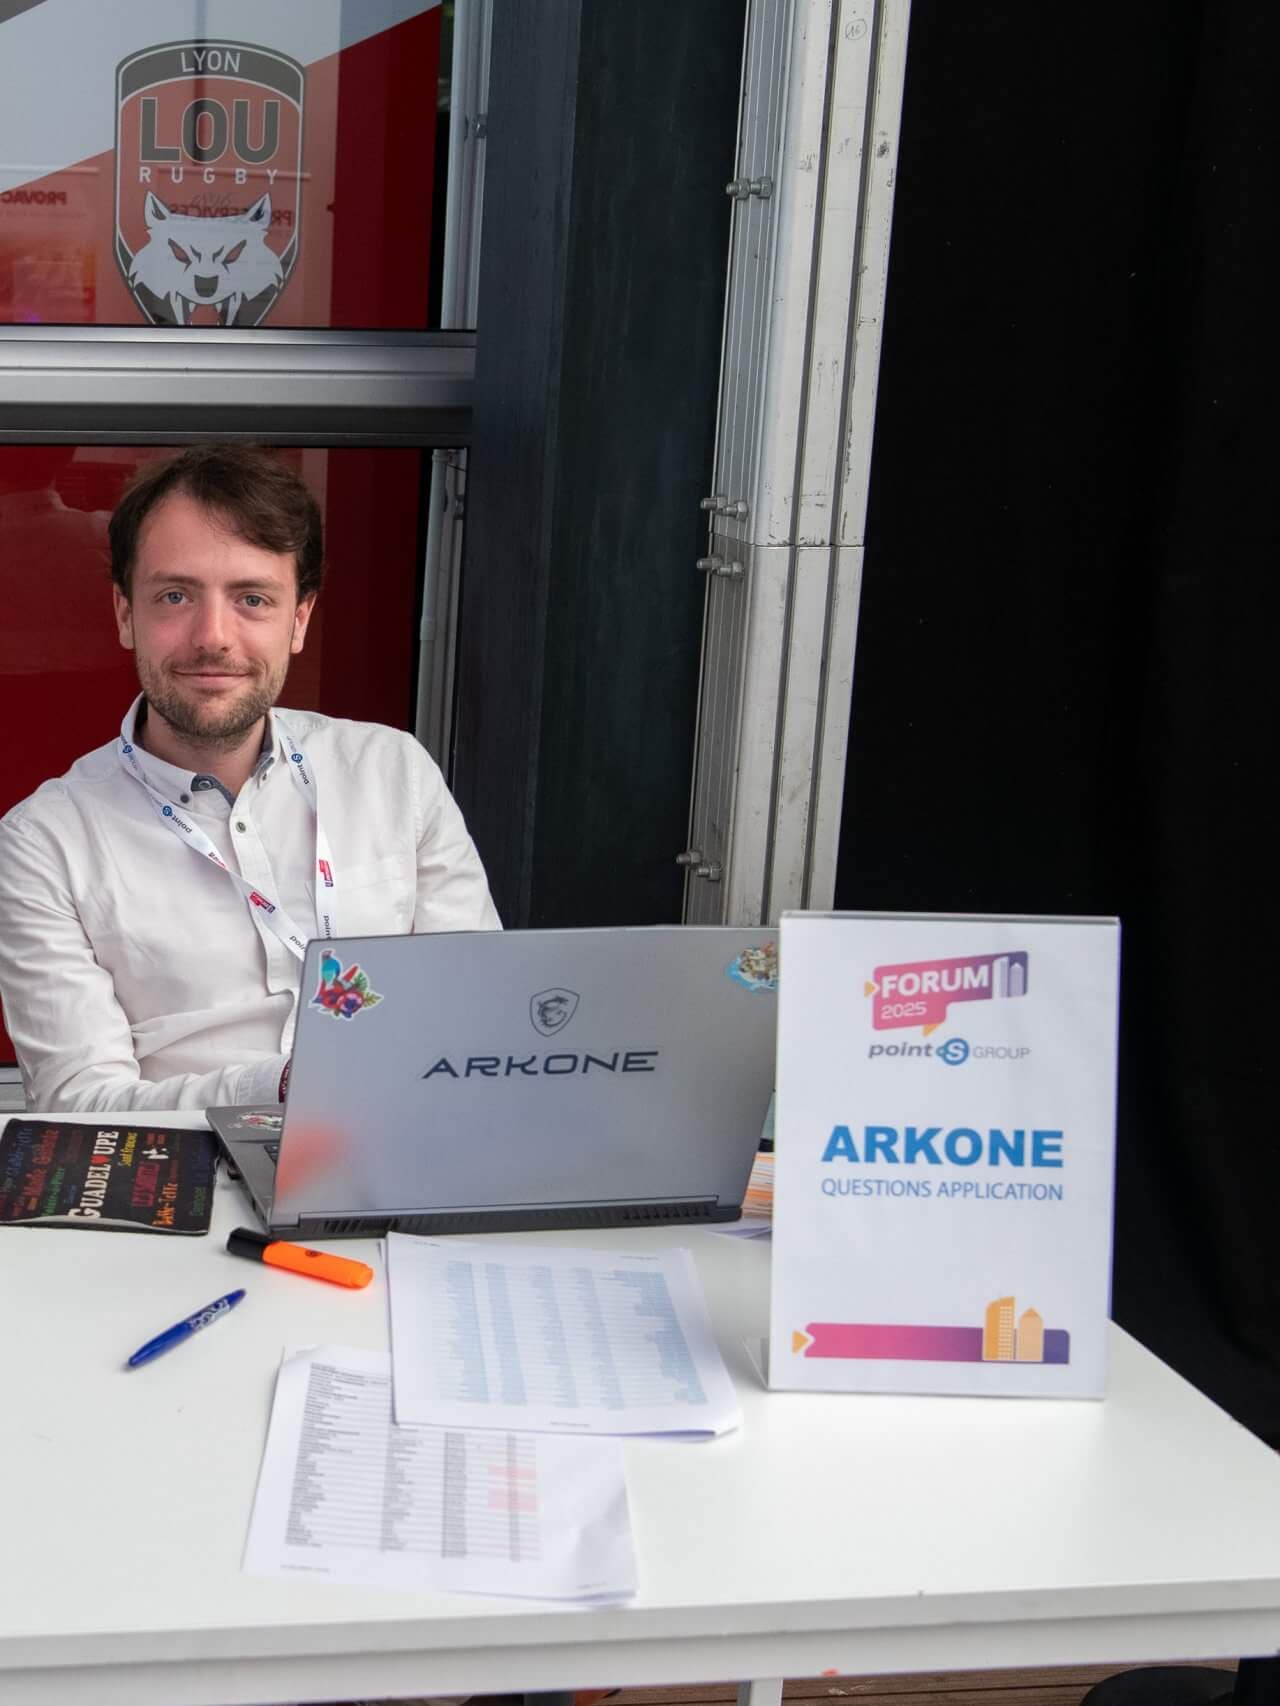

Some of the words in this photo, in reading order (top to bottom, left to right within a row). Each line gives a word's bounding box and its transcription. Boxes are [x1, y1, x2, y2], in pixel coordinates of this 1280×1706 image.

[180, 50, 240, 73] LYON
[139, 97, 281, 165] LOU
[138, 166, 279, 186] RUGBY
[298, 763, 309, 786] point
[171, 815, 193, 834] point
[323, 914, 331, 939] poin
[881, 964, 989, 998] FORUM
[880, 1001, 928, 1020] 2025
[868, 1041, 934, 1059] point
[972, 1046, 1032, 1060] GROUP
[422, 1051, 659, 1079] ARKONE
[820, 1125, 1063, 1168] ARKONE
[821, 1178, 932, 1198] QUESTIONS
[936, 1181, 1063, 1200] APPLICATION
